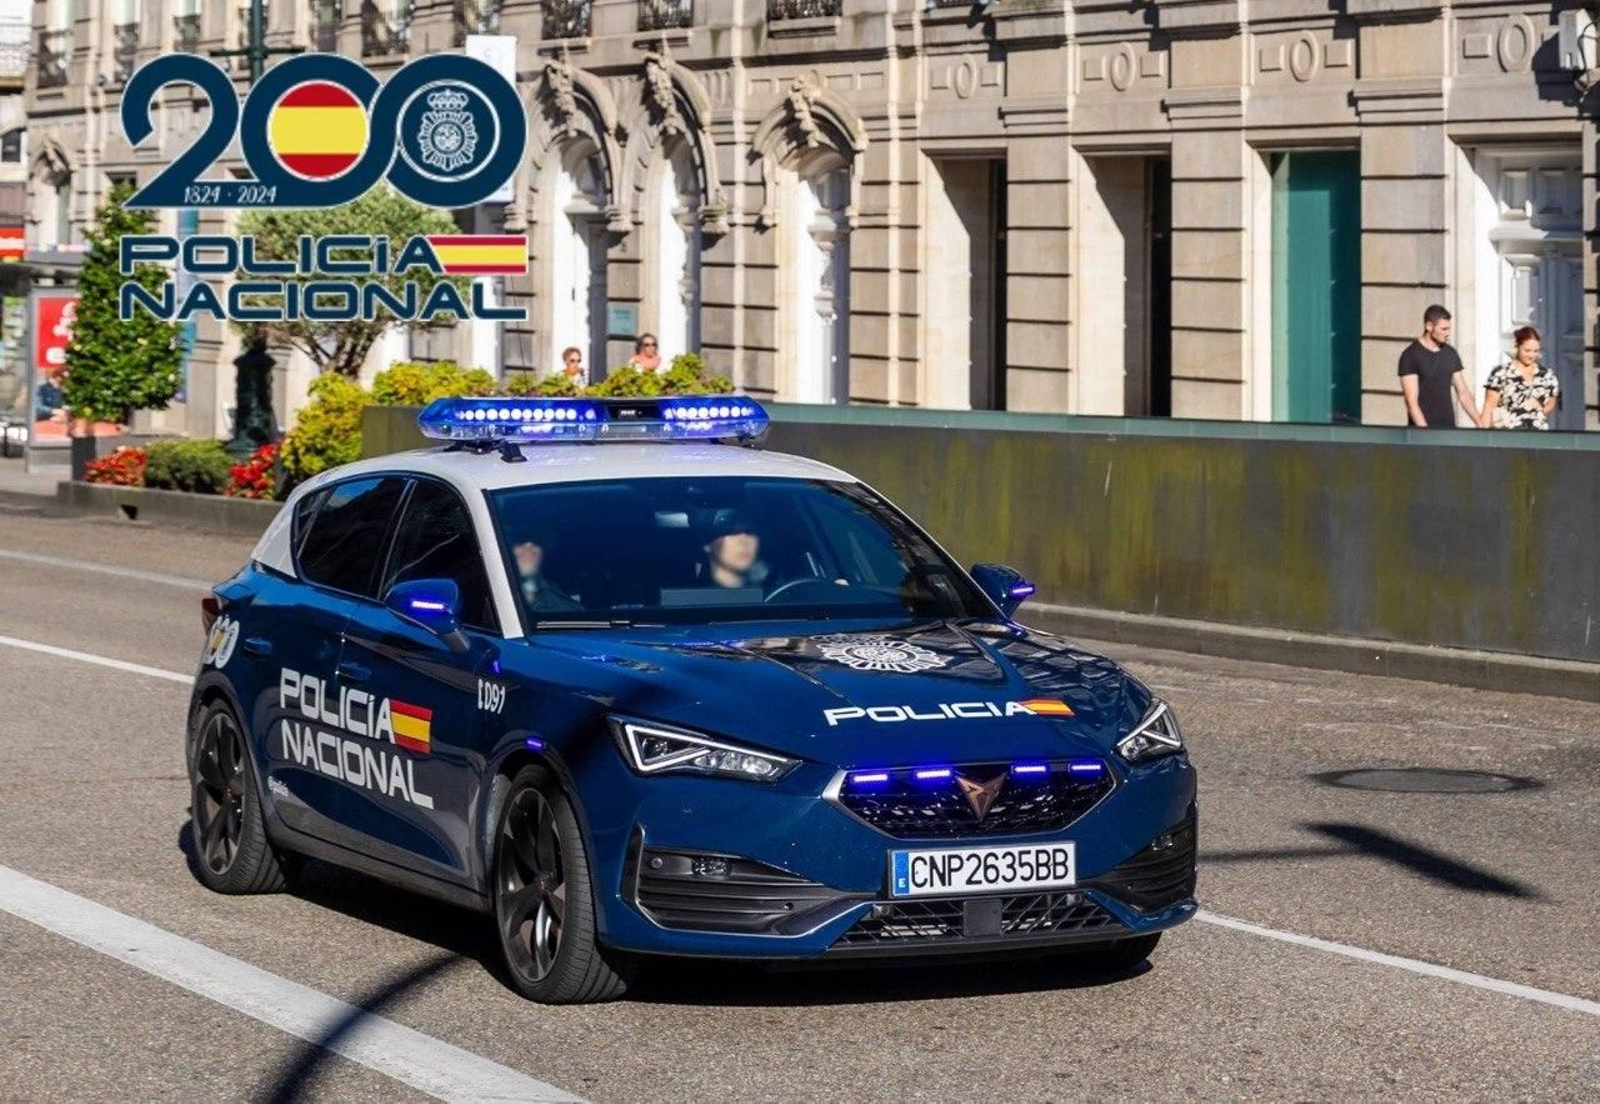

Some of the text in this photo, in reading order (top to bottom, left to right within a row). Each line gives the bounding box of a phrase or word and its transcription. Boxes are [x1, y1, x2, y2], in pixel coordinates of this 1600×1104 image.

[823, 700, 1037, 726] POLICIA
[281, 719, 434, 809] NACIONAL
[911, 848, 1069, 888] CNP2635BB
